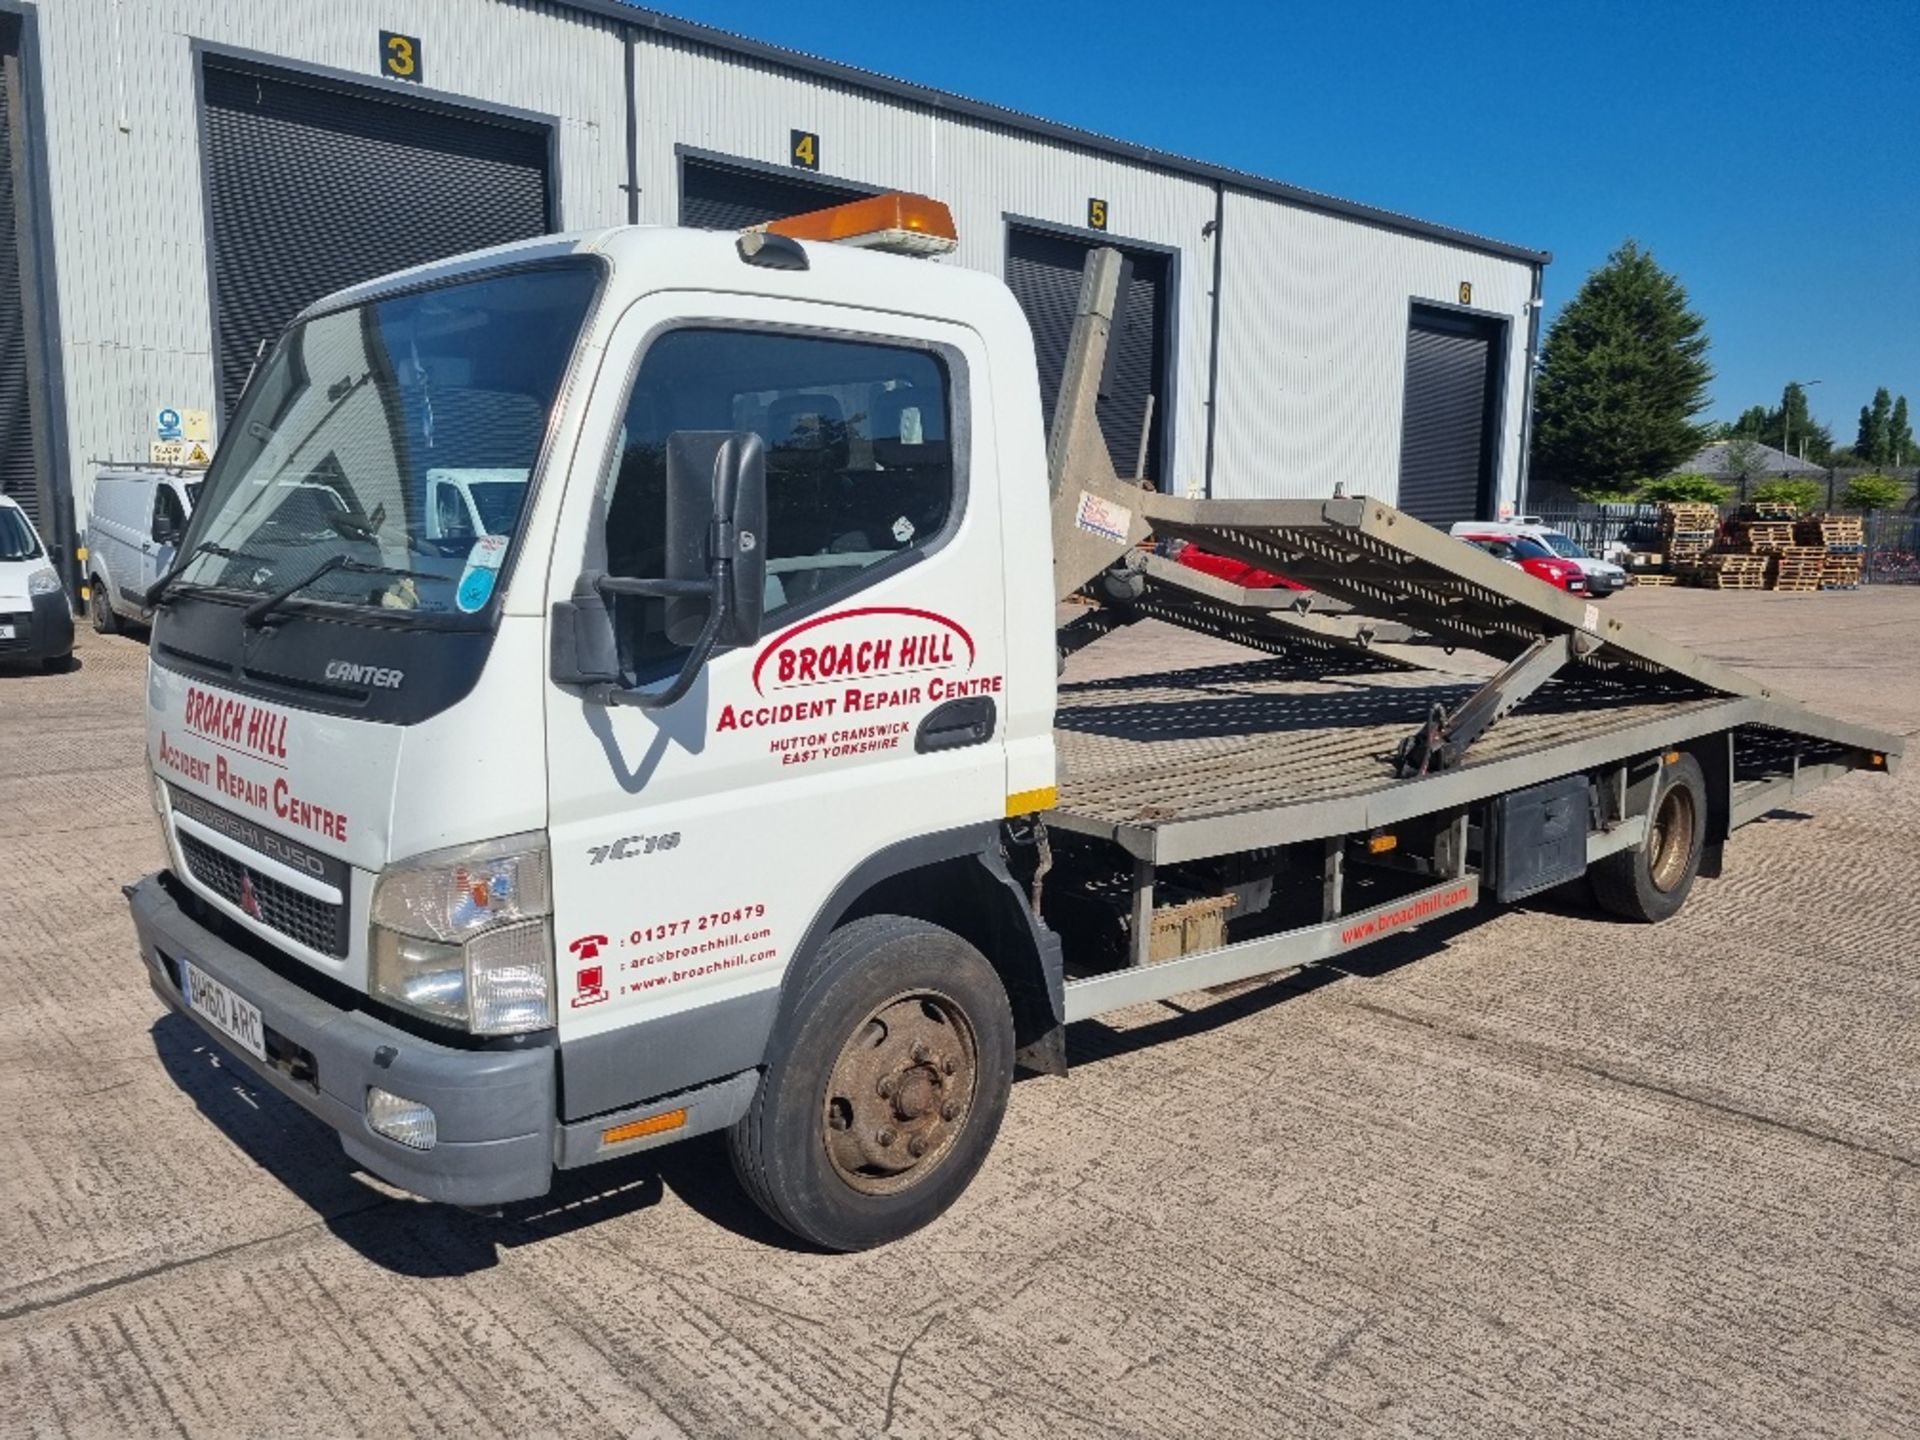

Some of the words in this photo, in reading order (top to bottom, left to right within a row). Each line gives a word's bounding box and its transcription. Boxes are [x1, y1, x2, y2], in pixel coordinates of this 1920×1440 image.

[388, 36, 415, 75] 3
[795, 135, 815, 165] 4
[1091, 201, 1105, 227] 5
[1461, 283, 1470, 303] 6
[325, 661, 405, 689] CANTER
[777, 639, 892, 683] BROACH
[899, 633, 954, 668] HILL
[185, 687, 247, 744] BROACH
[246, 706, 289, 760] HILL
[716, 698, 837, 733] ACCIDENT
[843, 686, 921, 714] REPAIR
[927, 675, 1003, 702] CENTRE
[769, 733, 828, 753] HUTTON
[831, 721, 910, 743] CRANSWICK
[782, 748, 818, 766] EAST
[822, 736, 899, 760] YORKSHIRE
[159, 730, 211, 786] ACCIDENT
[216, 753, 268, 811] REPAIR
[273, 776, 347, 843] CENTRE
[264, 836, 325, 876] FUSO
[629, 920, 691, 945] 01377
[697, 904, 766, 931] 270479
[1341, 886, 1469, 944] www.broachhill.com
[629, 949, 777, 993] www.broachhill.com
[230, 994, 262, 1053] ARC
